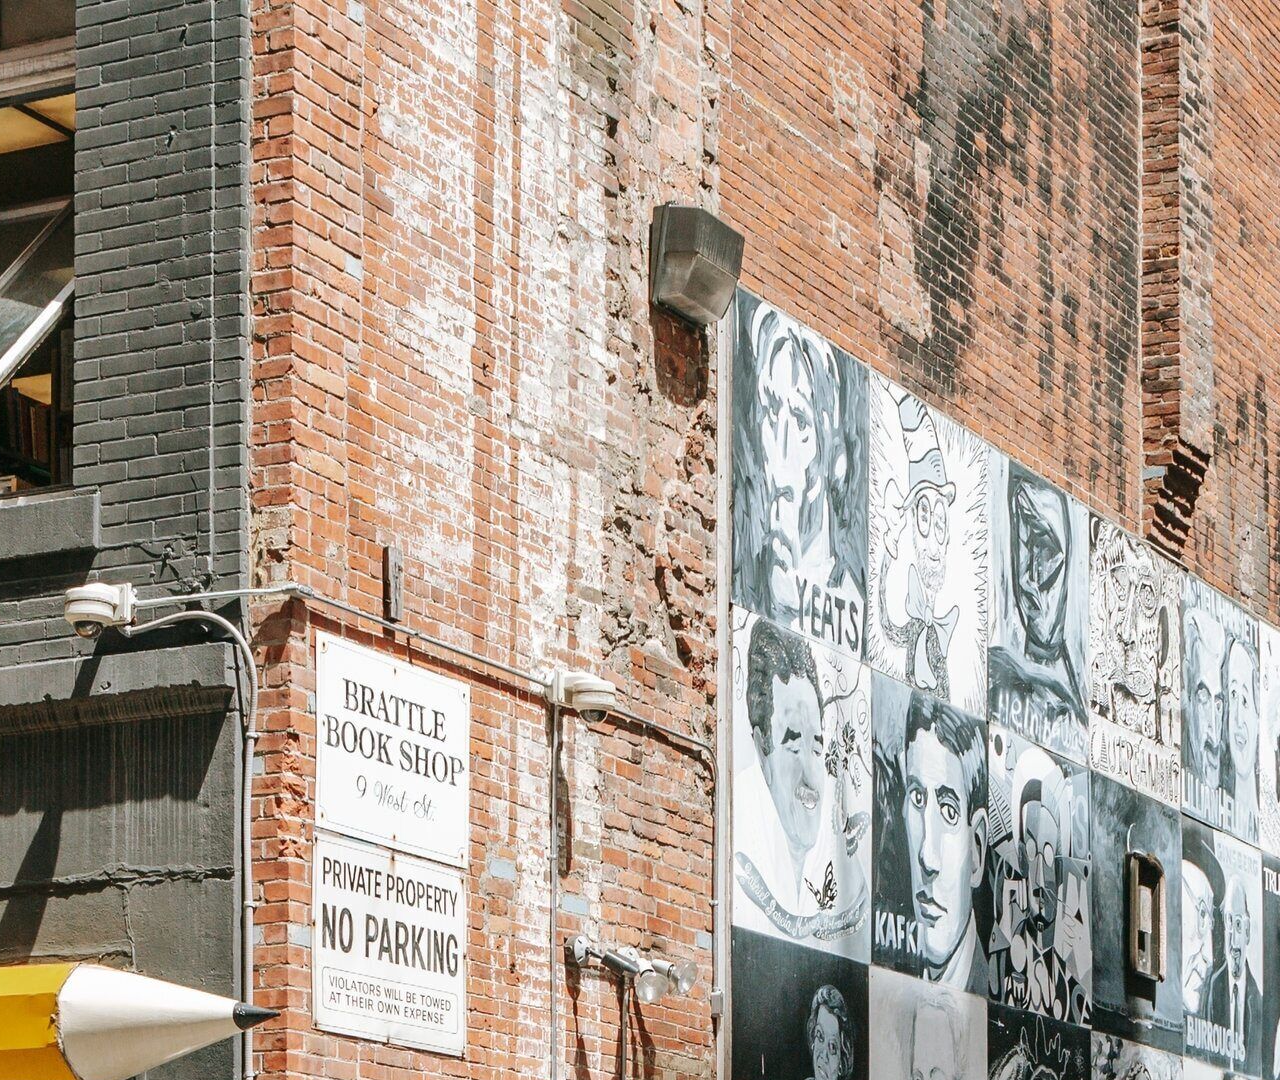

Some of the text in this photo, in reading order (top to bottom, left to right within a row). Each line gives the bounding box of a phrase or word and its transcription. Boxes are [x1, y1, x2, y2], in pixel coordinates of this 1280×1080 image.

[794, 574, 859, 653] YEATS
[342, 677, 447, 743] BRATTLE
[324, 714, 464, 787] BOOK SHOP
[356, 775, 436, 822] 9 West St.
[322, 856, 458, 919] PRIVATE PROPERTY
[321, 903, 459, 979] NO PARKING
[329, 974, 452, 1012] VIOLATORS WILL BE TOWED
[329, 991, 445, 1025] AT THEIR OWN EXPENSE
[1186, 1015, 1246, 1062] BURROUGHS
